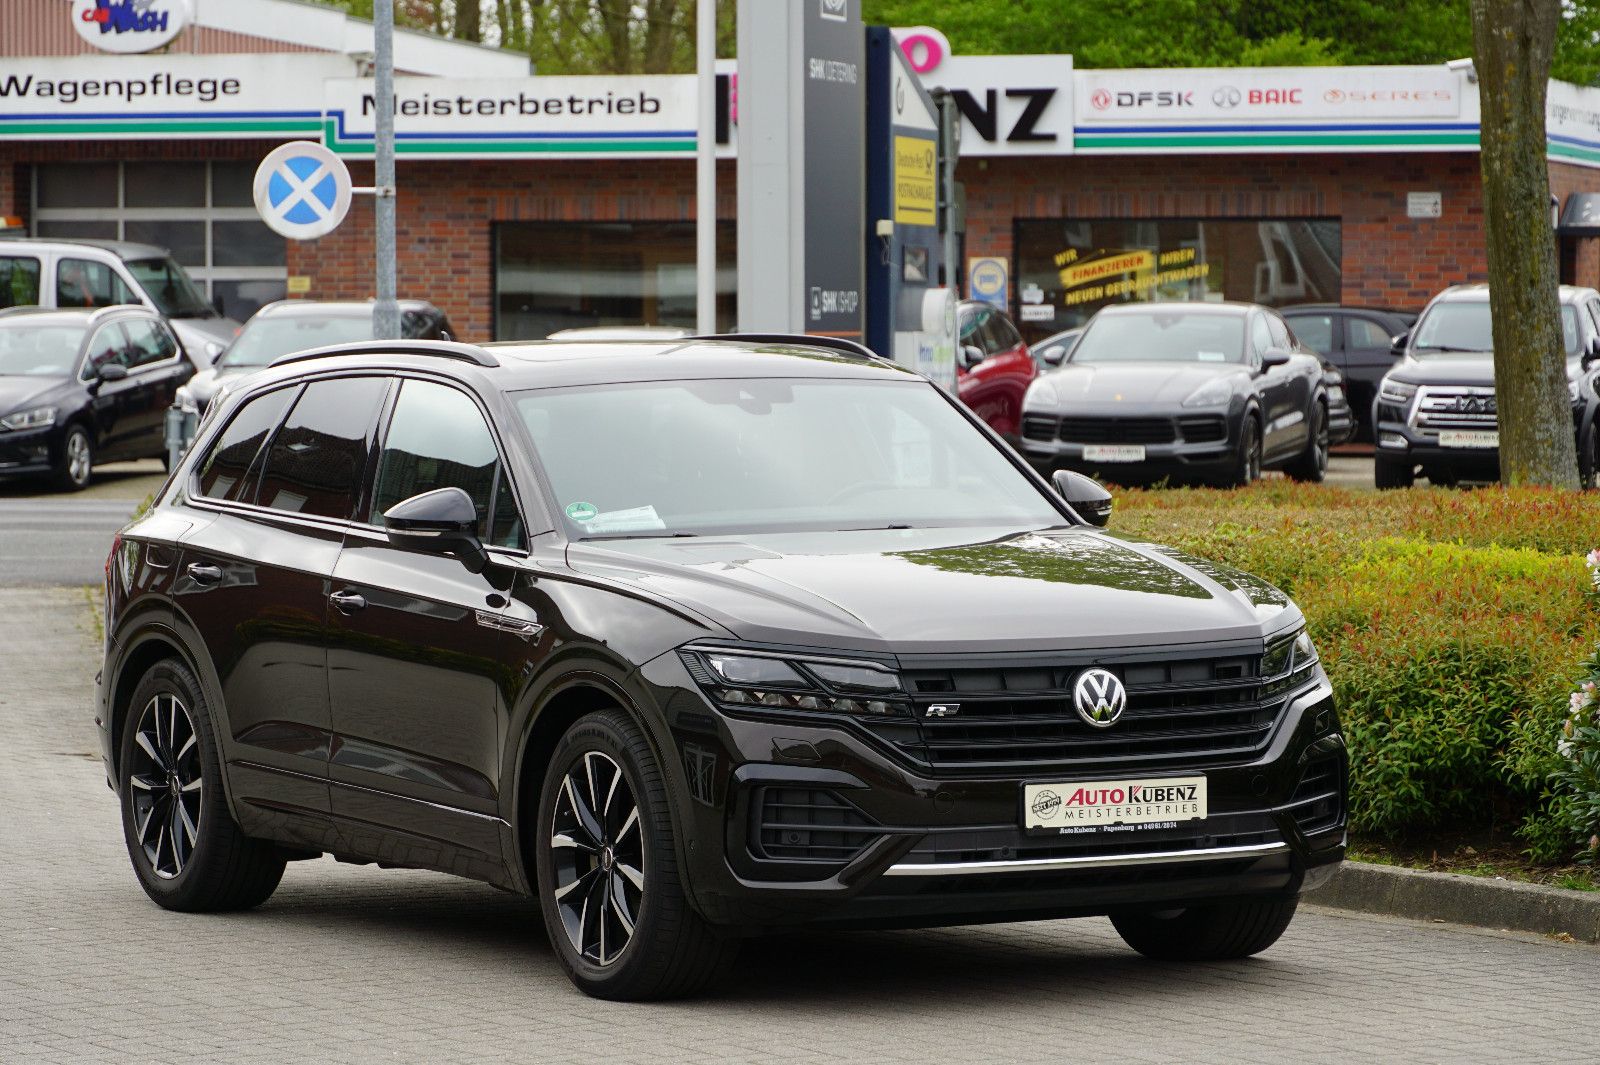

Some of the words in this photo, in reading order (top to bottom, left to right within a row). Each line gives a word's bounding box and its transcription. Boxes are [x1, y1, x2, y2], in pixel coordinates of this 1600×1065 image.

[0, 74, 240, 103] Wagenpflege
[1248, 88, 1303, 105] BAIC
[1349, 90, 1451, 102] SERES
[1117, 91, 1194, 107] DFSK
[1055, 248, 1078, 266] WIR
[1072, 255, 1145, 280] FINANZIEREN
[1160, 248, 1195, 265] IHREN
[1065, 286, 1104, 306] NEUEN
[1104, 263, 1210, 297] GEBRAUCHTWAGEN
[821, 290, 838, 312] SHK
[839, 290, 859, 313] SHOP
[1065, 788, 1125, 806] AUTO
[1128, 784, 1198, 804] KUBENZ
[1064, 803, 1198, 820] MEISTERBETRIEB
[1103, 824, 1135, 833] Papenburg
